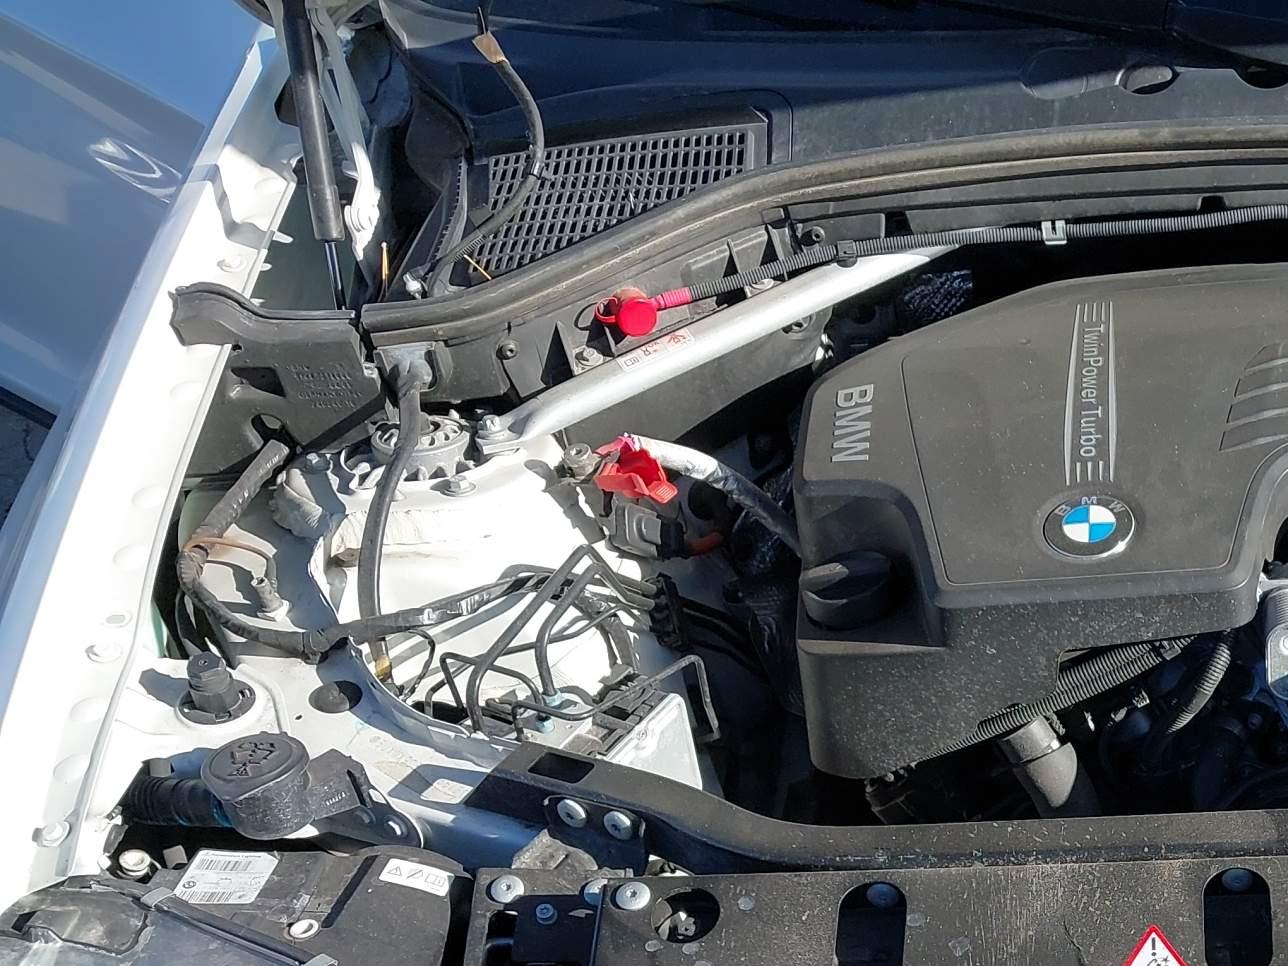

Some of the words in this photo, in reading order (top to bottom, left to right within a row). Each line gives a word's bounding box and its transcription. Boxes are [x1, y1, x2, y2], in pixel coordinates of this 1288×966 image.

[1079, 323, 1105, 402] TwinPower
[831, 383, 874, 462] BMW
[1079, 405, 1103, 457] Turbo
[1053, 495, 1126, 516] BMW
